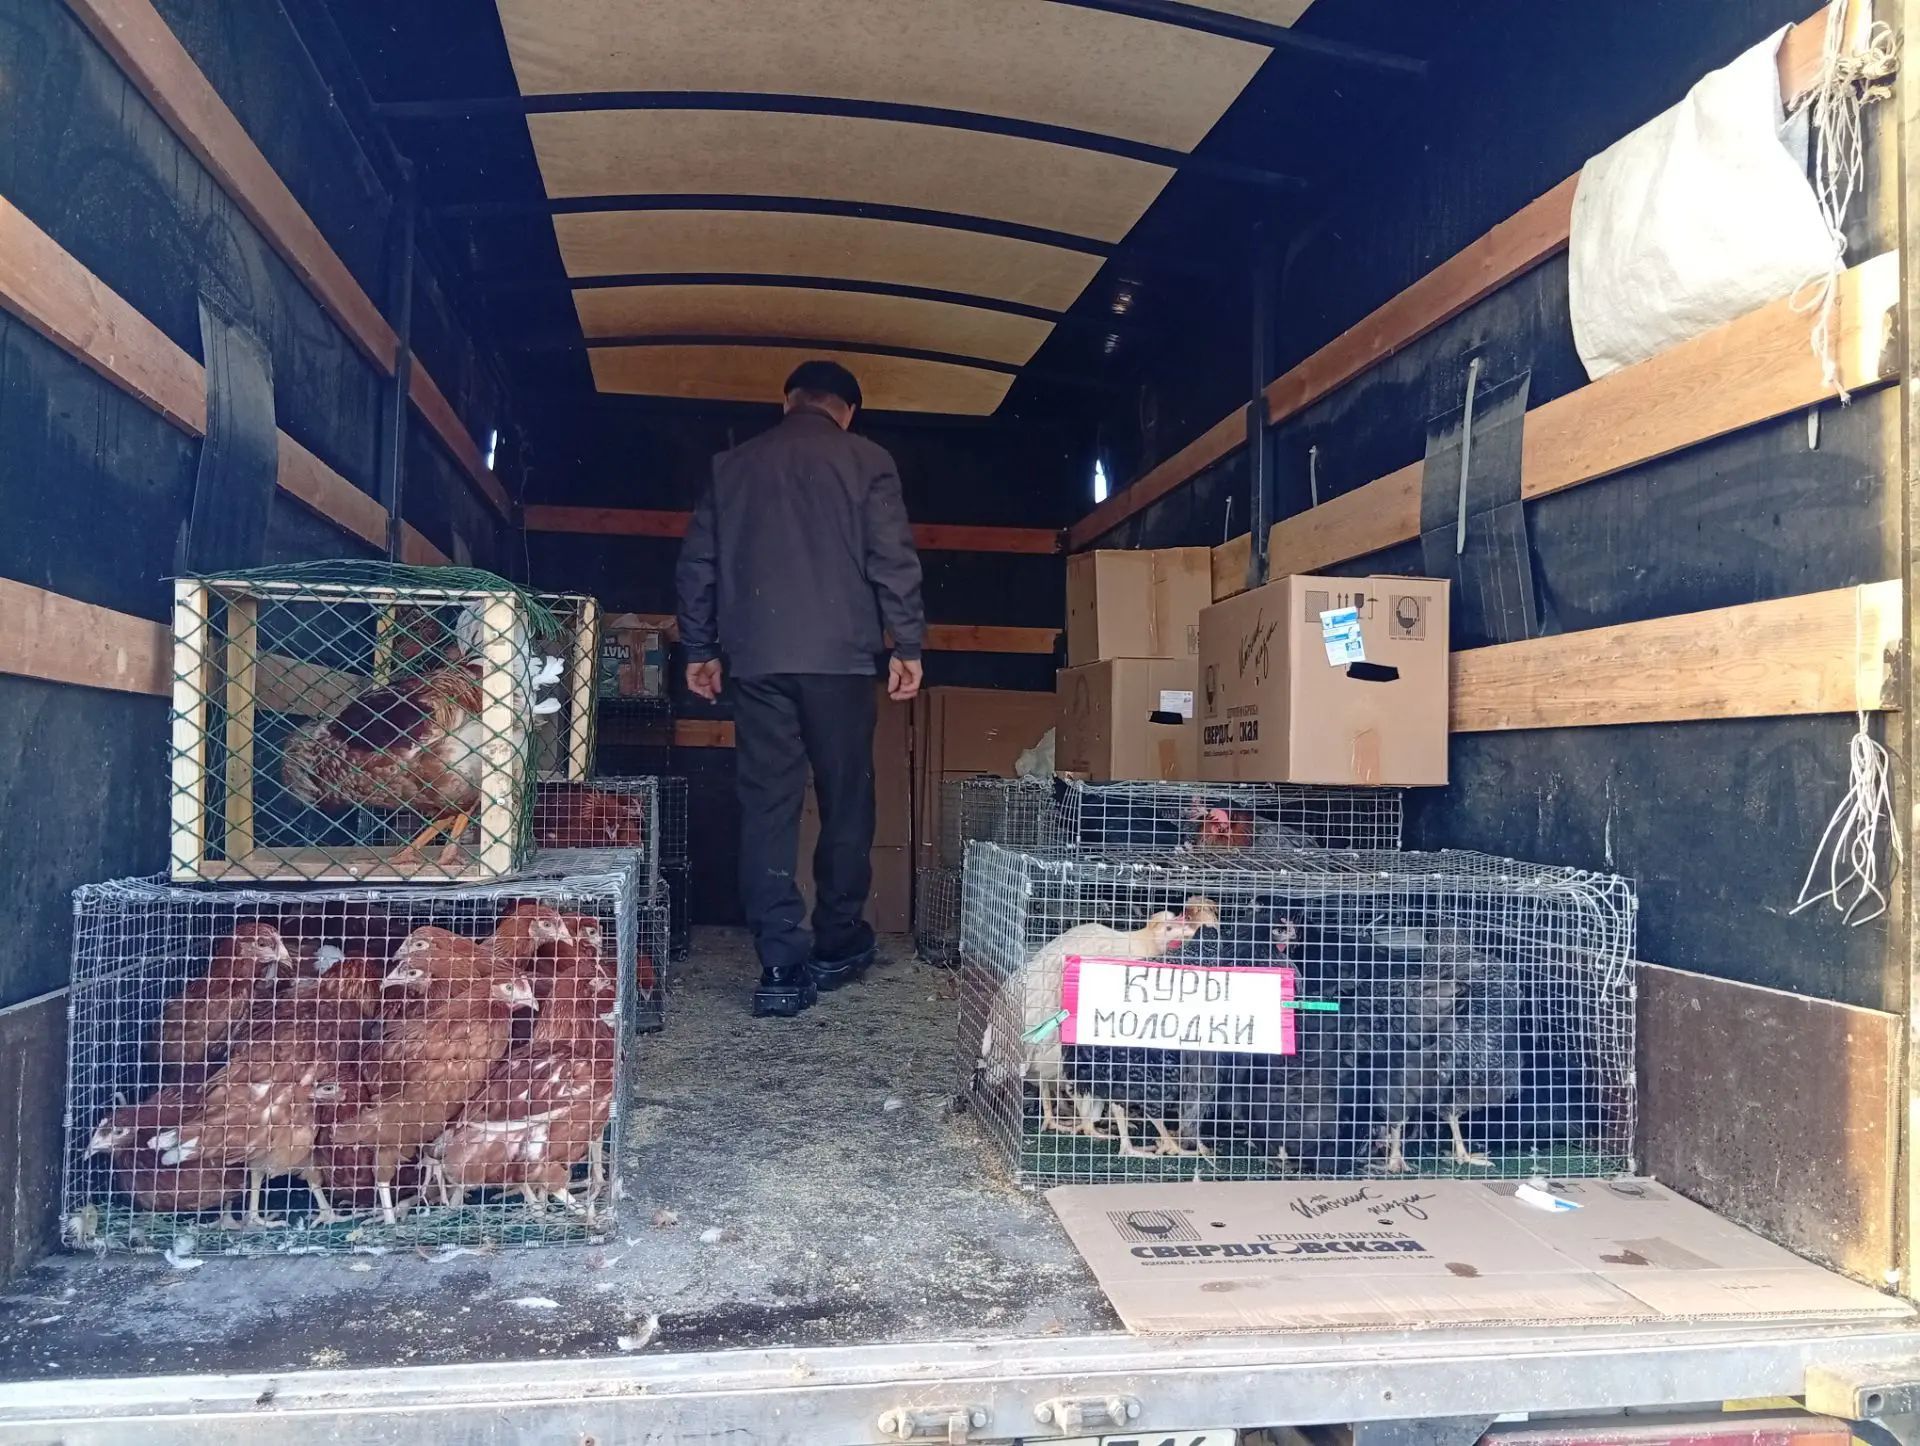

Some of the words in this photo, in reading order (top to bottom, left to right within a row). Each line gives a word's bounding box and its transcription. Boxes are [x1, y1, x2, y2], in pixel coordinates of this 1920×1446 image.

[1123, 965, 1230, 1003] КУРЫ
[1094, 1008, 1255, 1045] МОЛОДКИ
[1256, 1231, 1412, 1242] ПТИЦЕФАБРИКА
